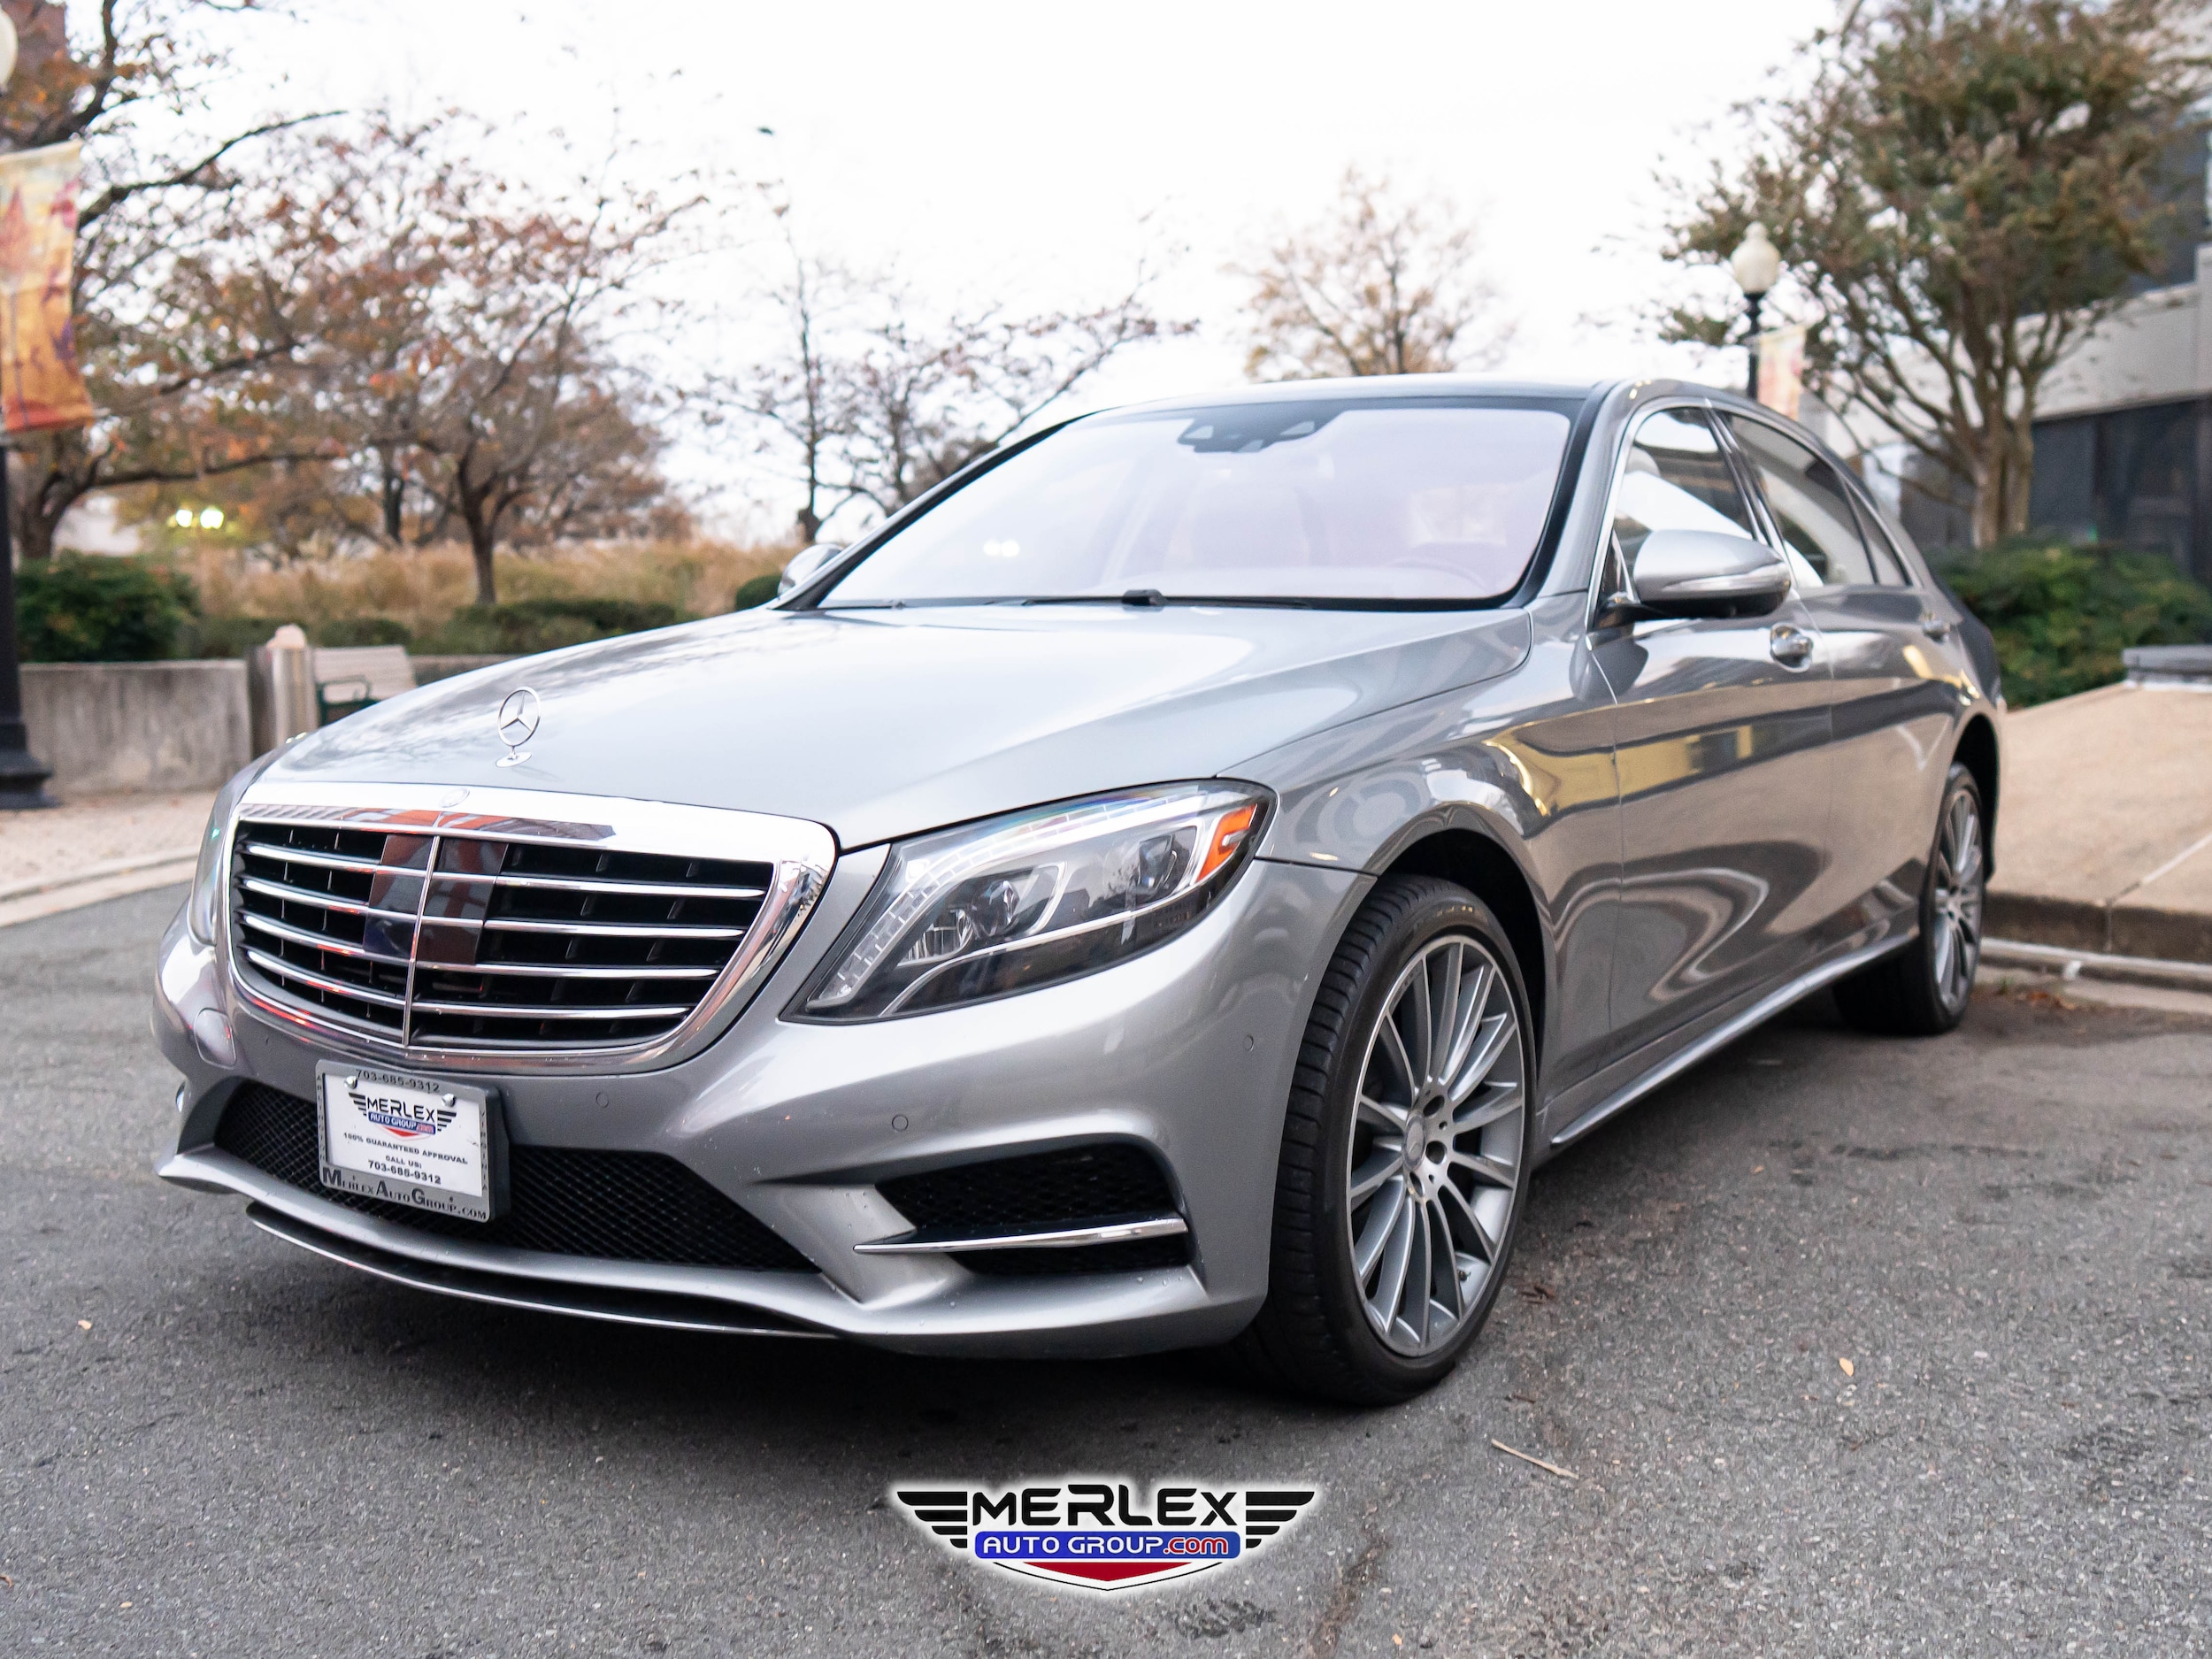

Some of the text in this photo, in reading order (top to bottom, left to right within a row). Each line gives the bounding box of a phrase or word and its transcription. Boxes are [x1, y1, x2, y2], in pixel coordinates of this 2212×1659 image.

[366, 1096, 435, 1123] MERLEX
[370, 1112, 390, 1125] AUTO
[343, 1132, 468, 1164] 100% GUARANTEED APPROVAL
[385, 1155, 405, 1165] CALL
